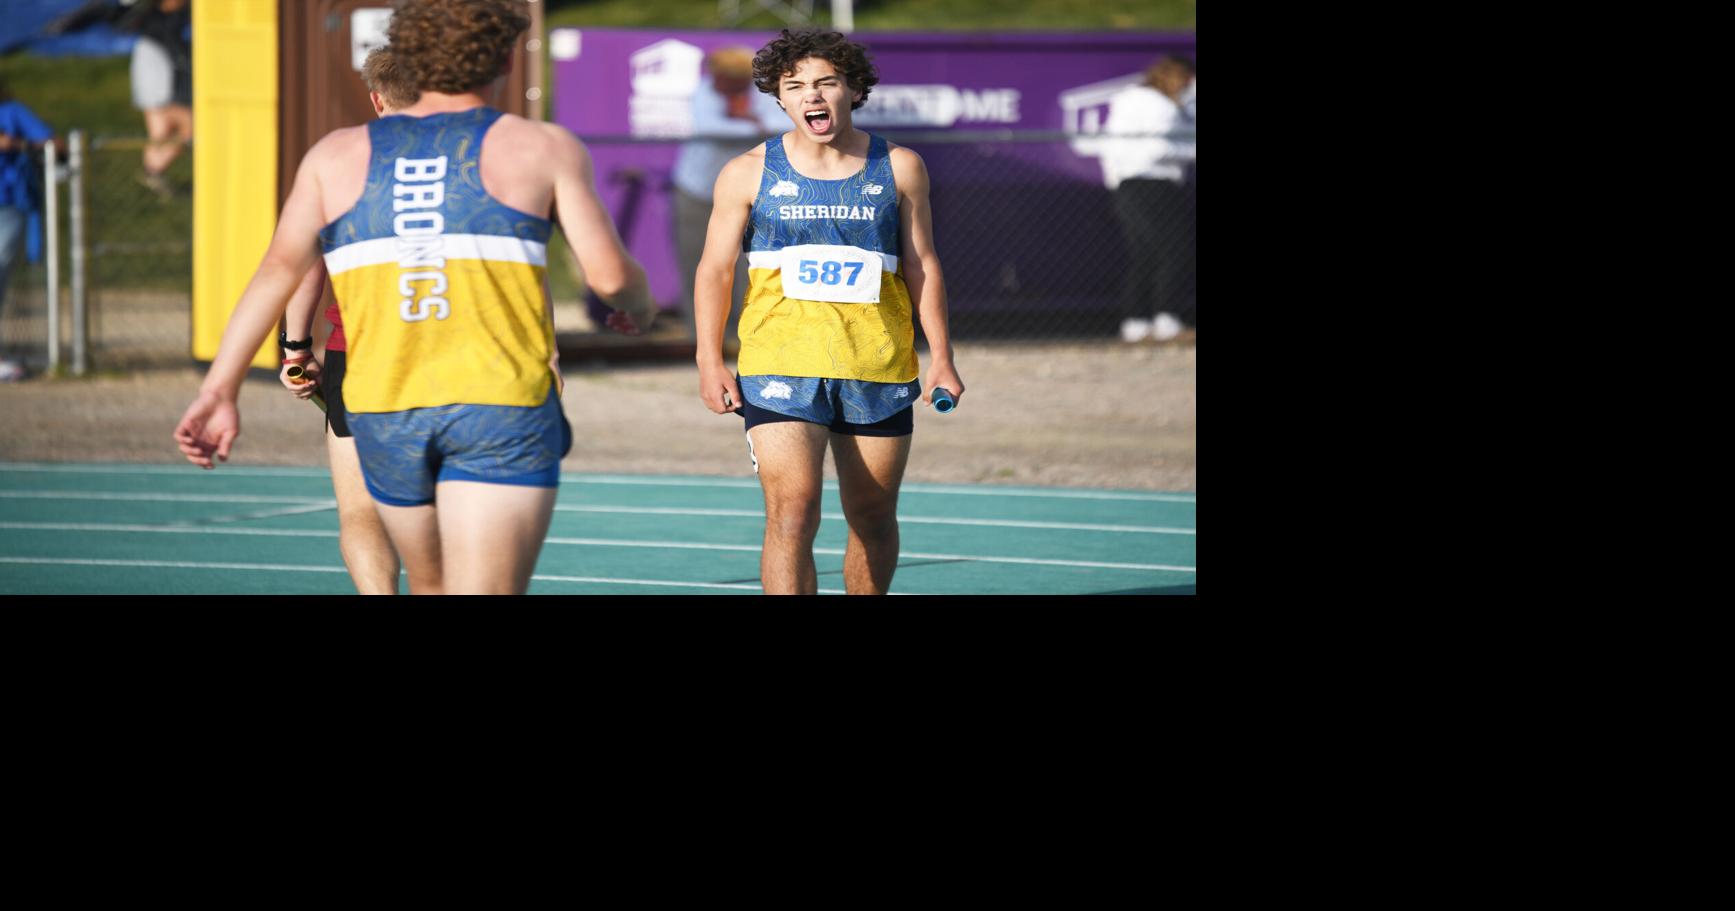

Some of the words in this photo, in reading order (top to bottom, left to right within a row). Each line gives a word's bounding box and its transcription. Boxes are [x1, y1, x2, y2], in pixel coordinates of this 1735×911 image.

[779, 204, 876, 221] SHERIDAN
[393, 155, 450, 322] BRONCS
[798, 260, 864, 287] 587
